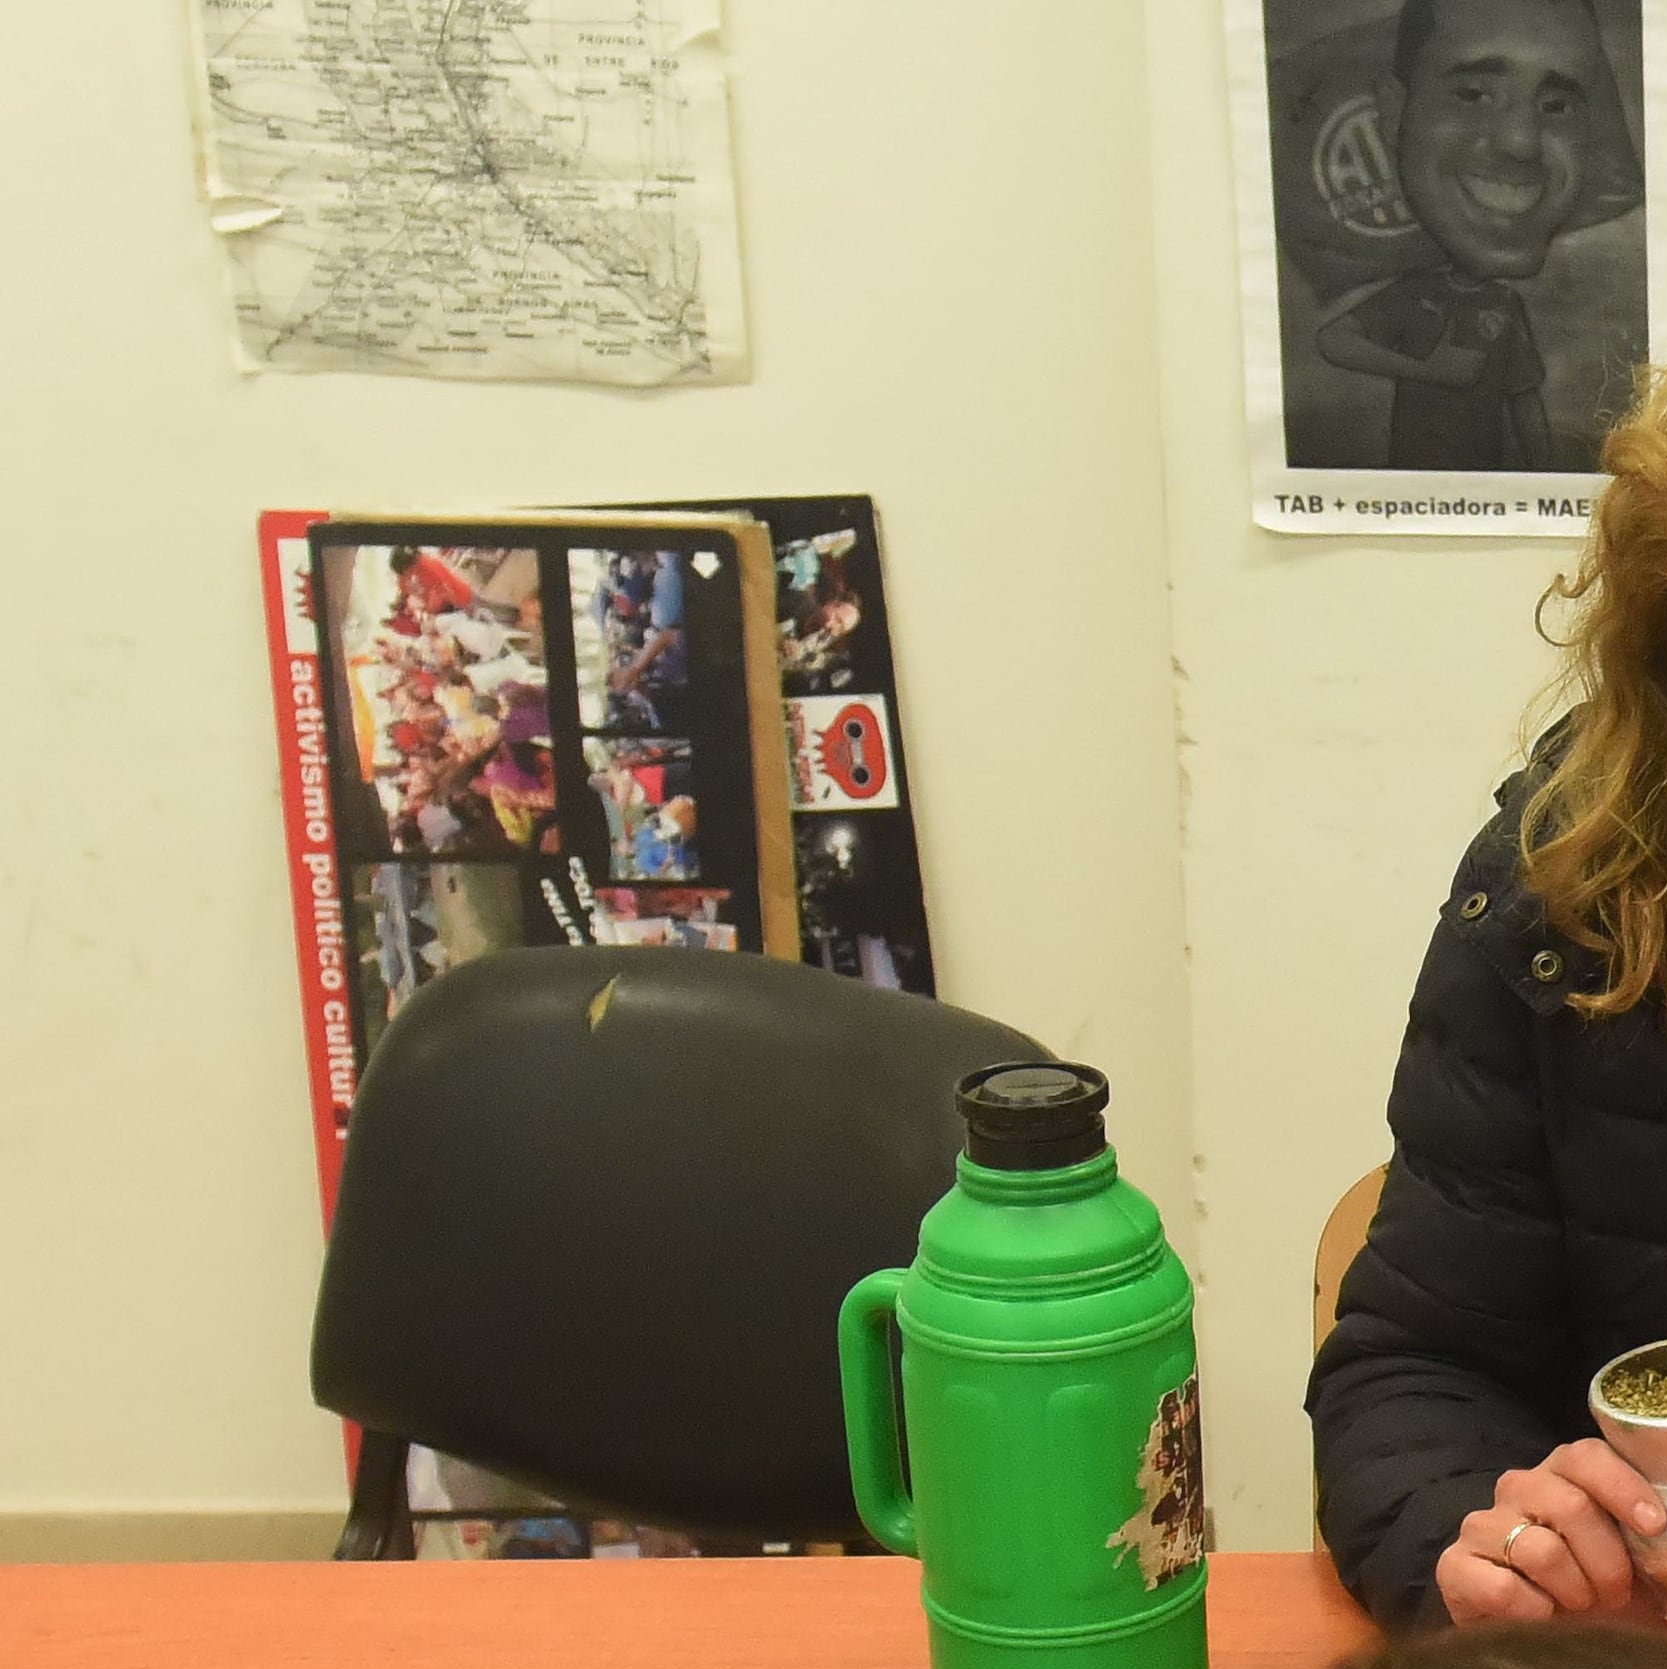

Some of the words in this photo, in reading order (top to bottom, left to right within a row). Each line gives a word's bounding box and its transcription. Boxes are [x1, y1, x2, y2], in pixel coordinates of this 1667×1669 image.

[1274, 494, 1324, 513] TAB
[1355, 496, 1507, 519] espaciadora
[290, 658, 330, 843] activismo
[323, 1000, 356, 1140] cultur
